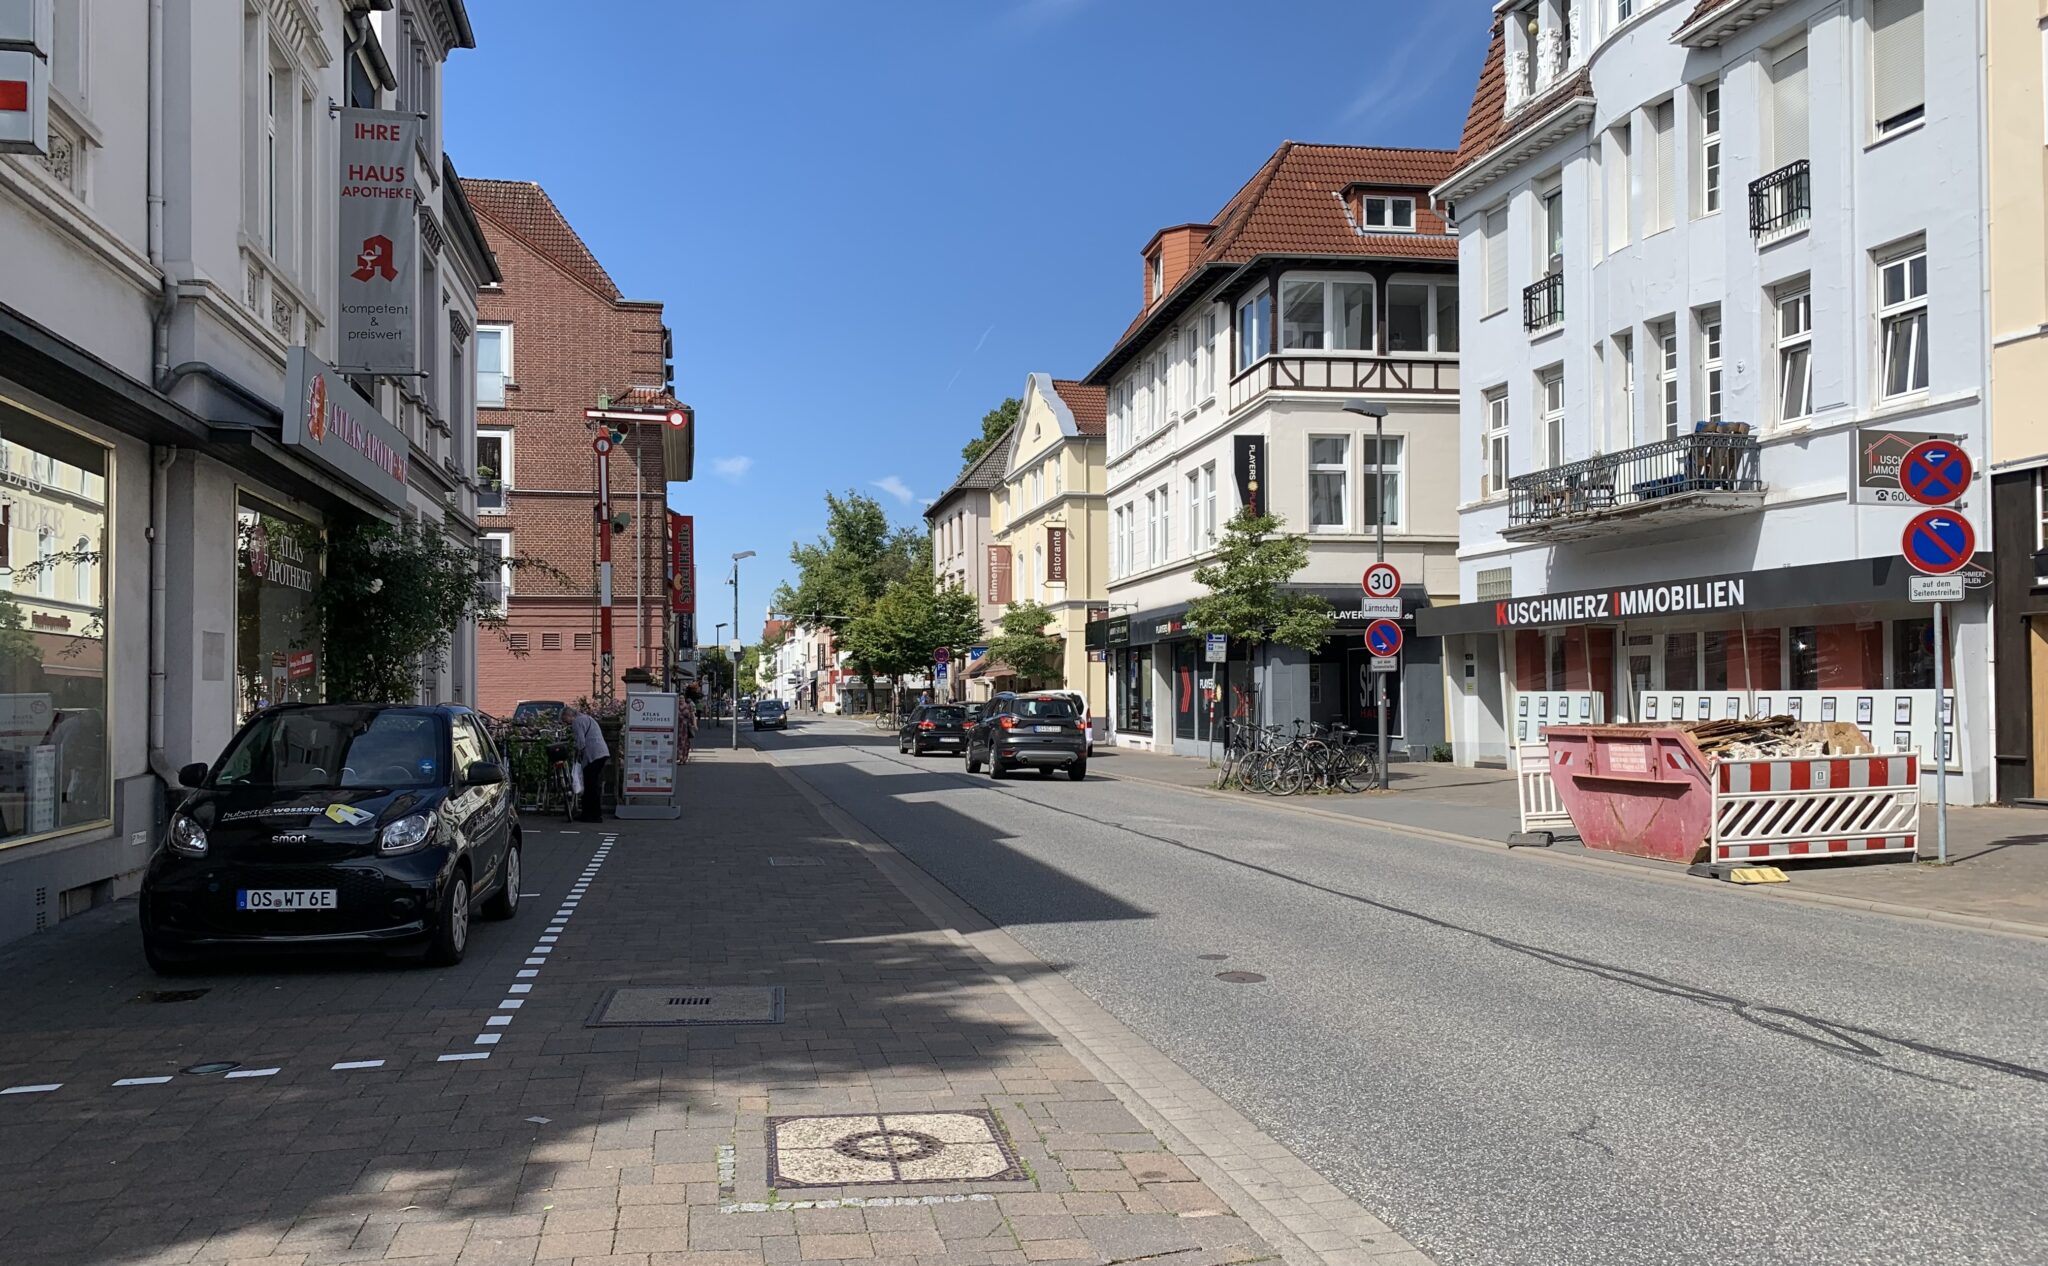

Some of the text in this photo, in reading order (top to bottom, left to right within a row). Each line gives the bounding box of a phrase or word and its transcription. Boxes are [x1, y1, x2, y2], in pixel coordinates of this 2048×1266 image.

[354, 123, 400, 141] IHRE
[349, 164, 405, 182] HAUS
[341, 185, 412, 199] APOTHEKE
[341, 304, 408, 315] kompetent
[370, 316, 379, 326] &
[348, 329, 402, 341] preiswert
[1248, 444, 1257, 480] PLAYERS
[279, 534, 304, 563] ATLAS
[1053, 530, 1062, 579] ristorante
[267, 559, 313, 593] APOTHEKE
[989, 548, 998, 602] alimentari
[1371, 573, 1393, 590] 30
[1913, 589, 1960, 597] Seitenstreifen
[1495, 578, 1745, 626] KUSCHMIERZ IMMOBILIEN
[271, 833, 307, 844] smart
[251, 891, 272, 907] OS
[284, 891, 305, 907] WT
[309, 891, 331, 907] 6E
